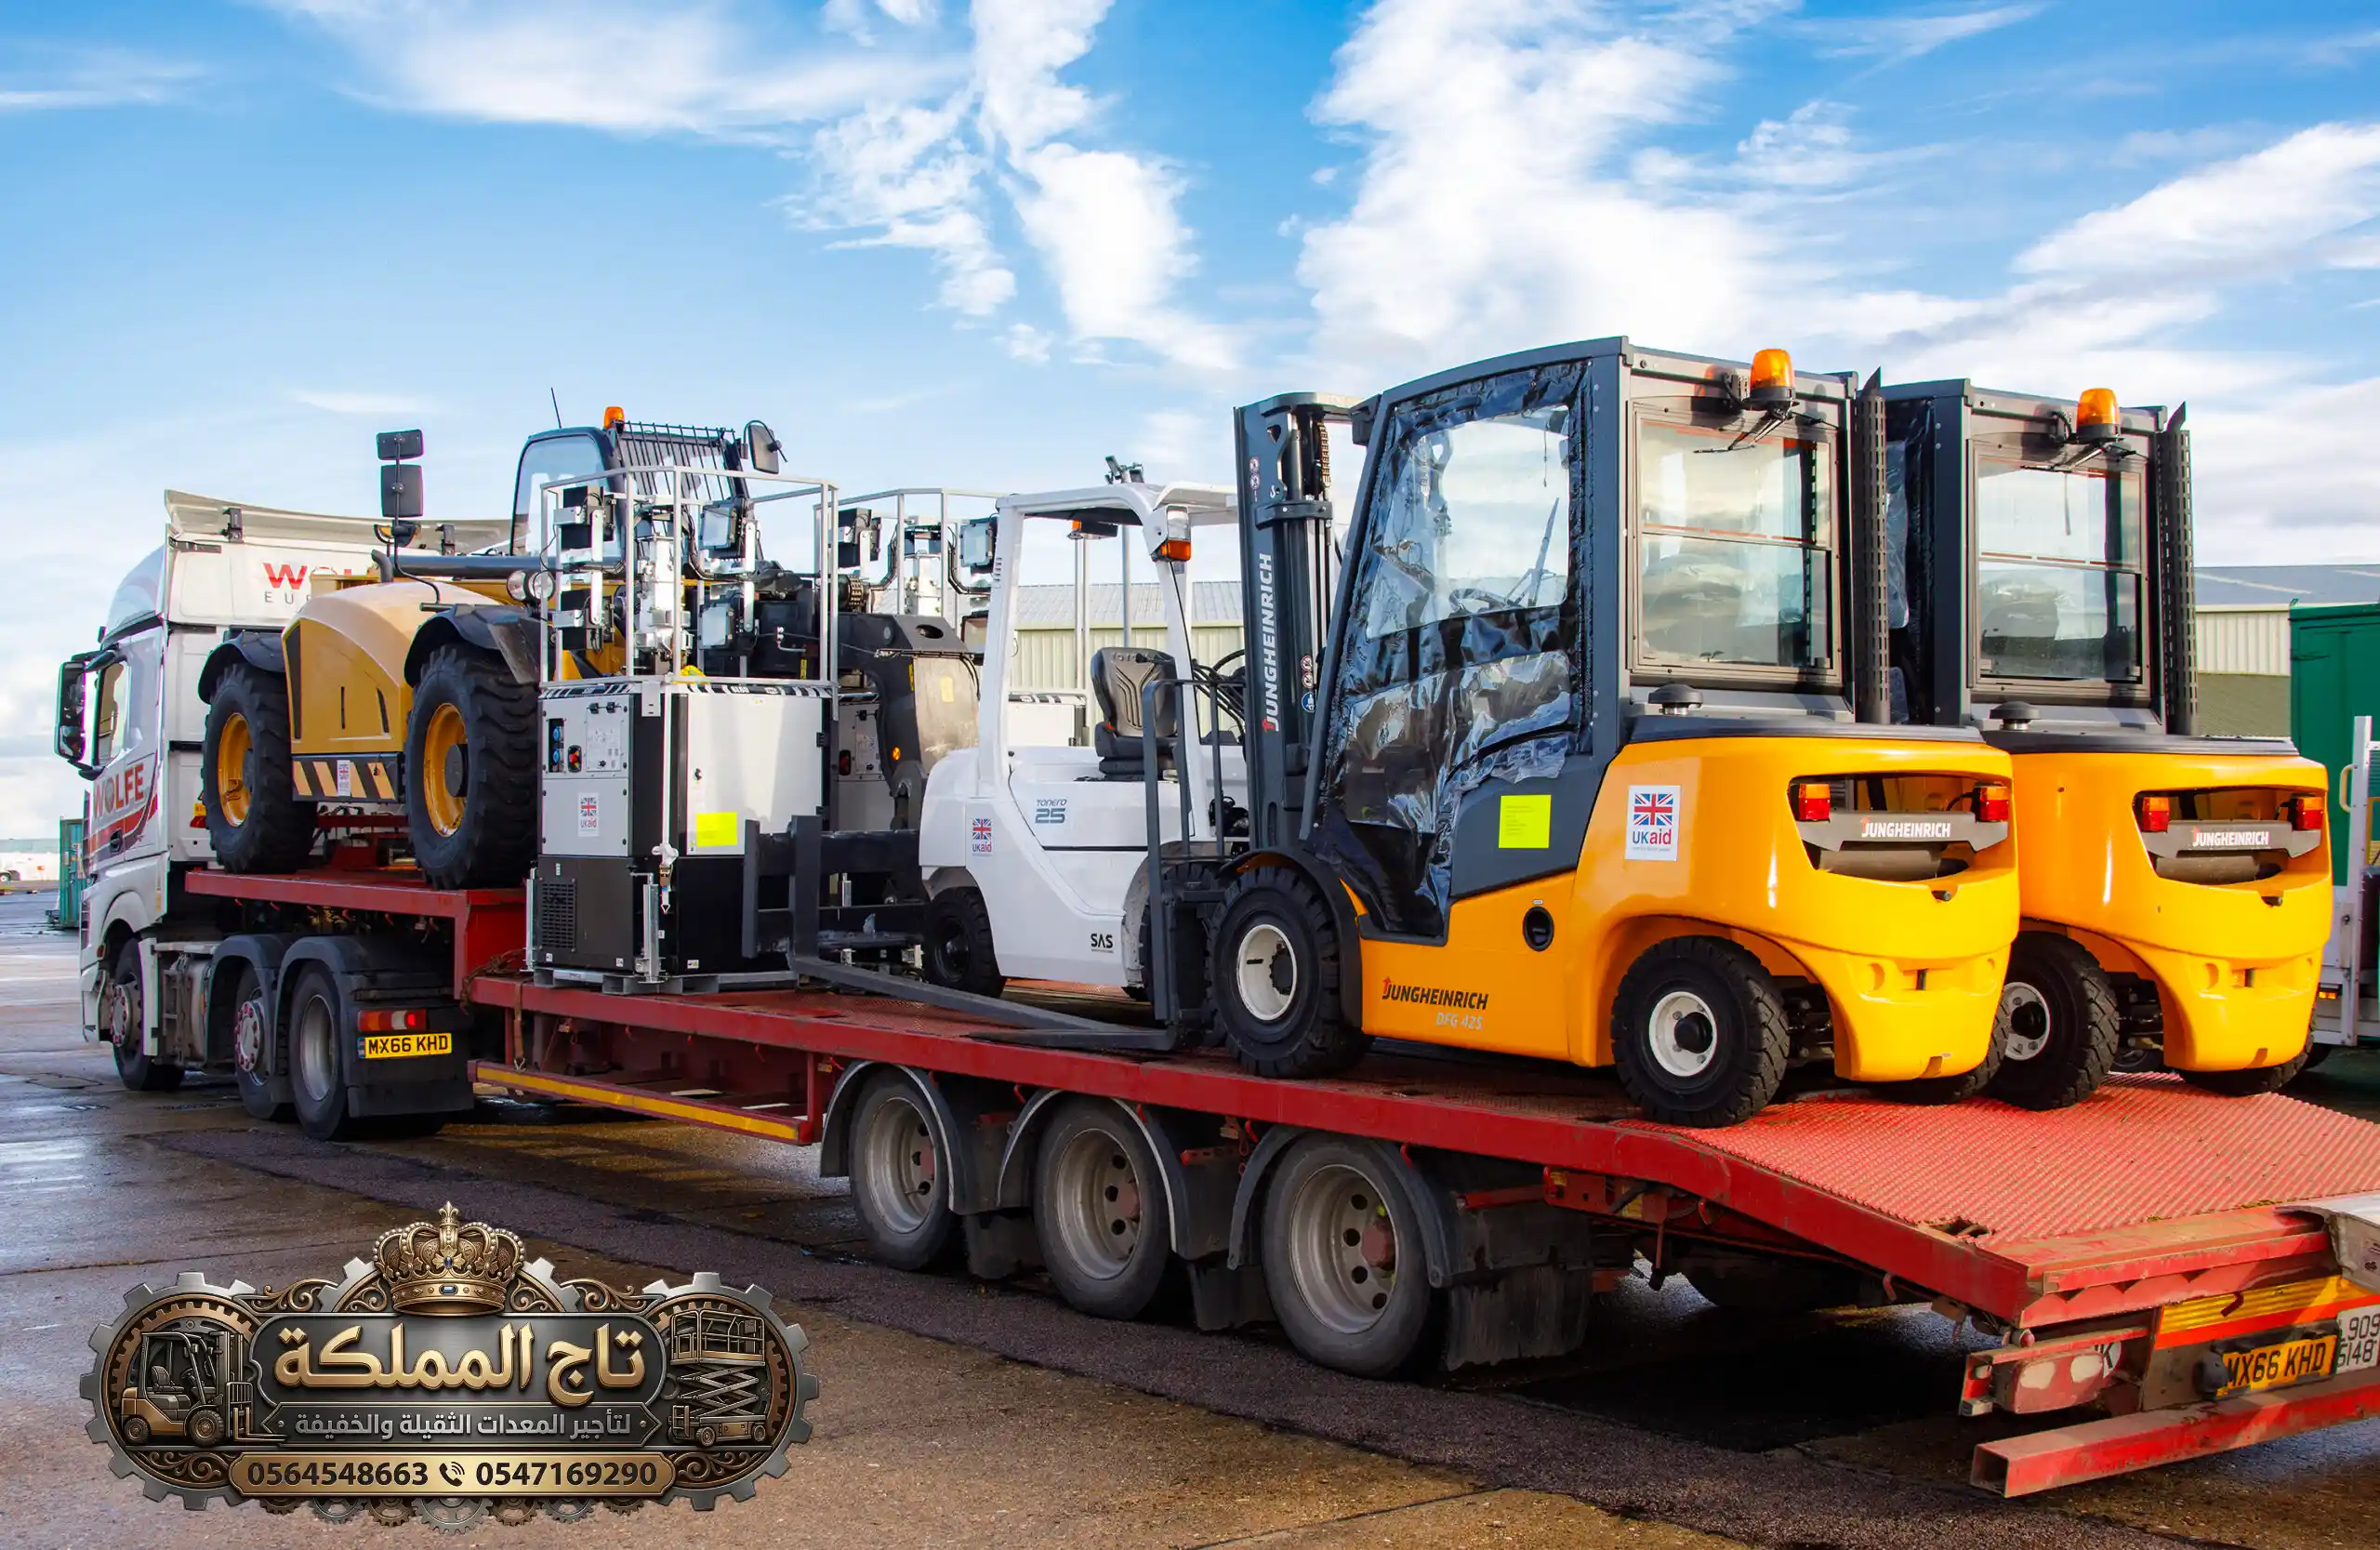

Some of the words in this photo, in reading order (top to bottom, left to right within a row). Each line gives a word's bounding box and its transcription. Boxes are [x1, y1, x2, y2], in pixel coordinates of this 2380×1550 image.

[1261, 552, 1280, 733] JUNGHEINRICH
[1035, 808, 1065, 824] 25
[1861, 818, 1951, 838] JUNGHEINRICH
[2192, 828, 2270, 847] JUNGHEINRICH
[1091, 933, 1114, 948] SAS
[1382, 977, 1489, 1011] JUNGHEINRICH
[1435, 1012, 1459, 1028] DFG
[1461, 1014, 1484, 1030] 425
[368, 1038, 412, 1054] MX66
[416, 1035, 449, 1052] KHD
[2284, 1342, 2327, 1377] KHD
